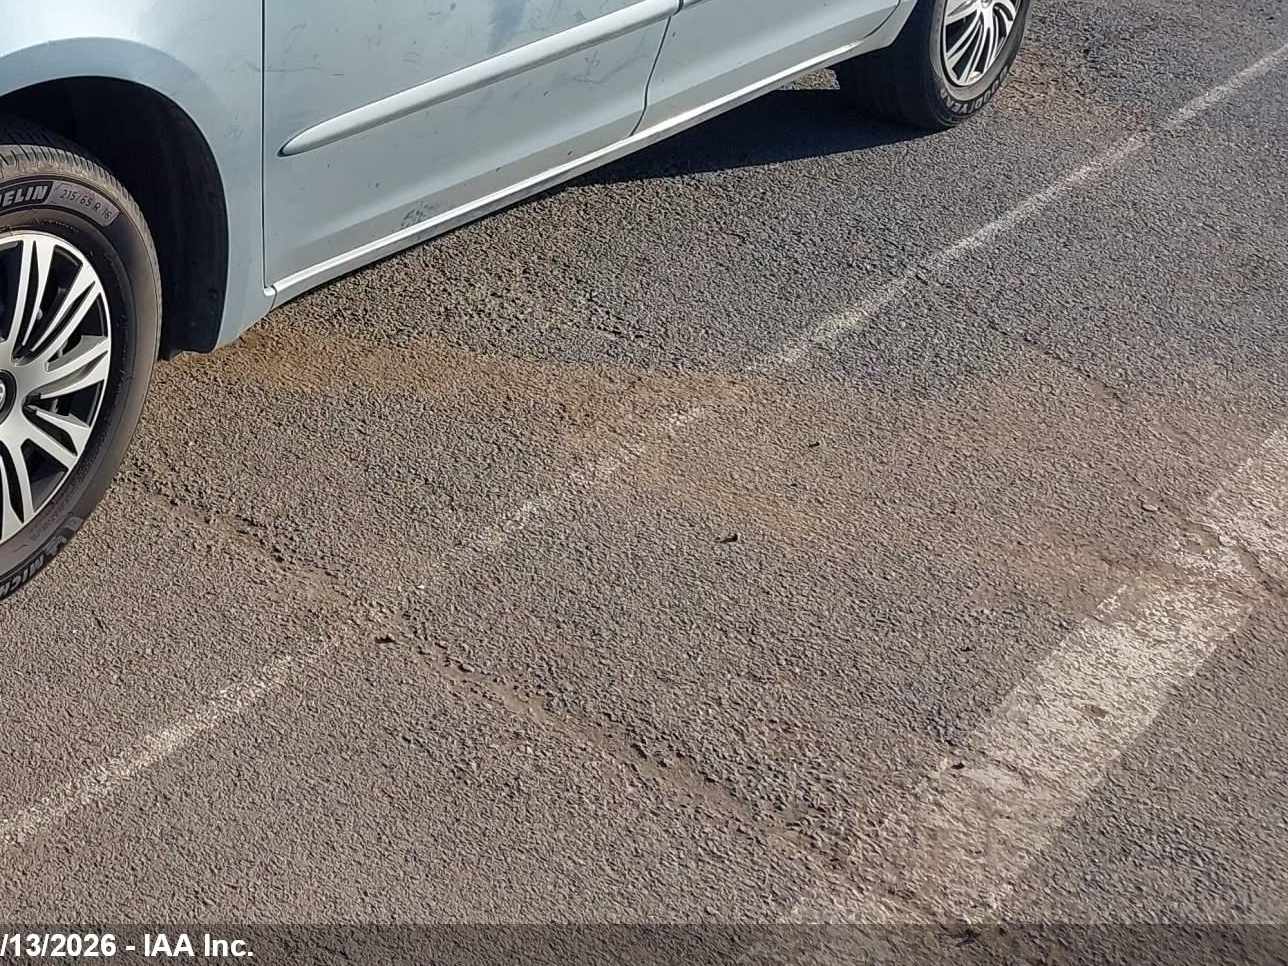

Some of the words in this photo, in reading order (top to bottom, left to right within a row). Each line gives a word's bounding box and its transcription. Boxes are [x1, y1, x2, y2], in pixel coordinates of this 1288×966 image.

[60, 189, 93, 208] 215/65
[93, 202, 102, 212] R
[103, 207, 112, 219] 16
